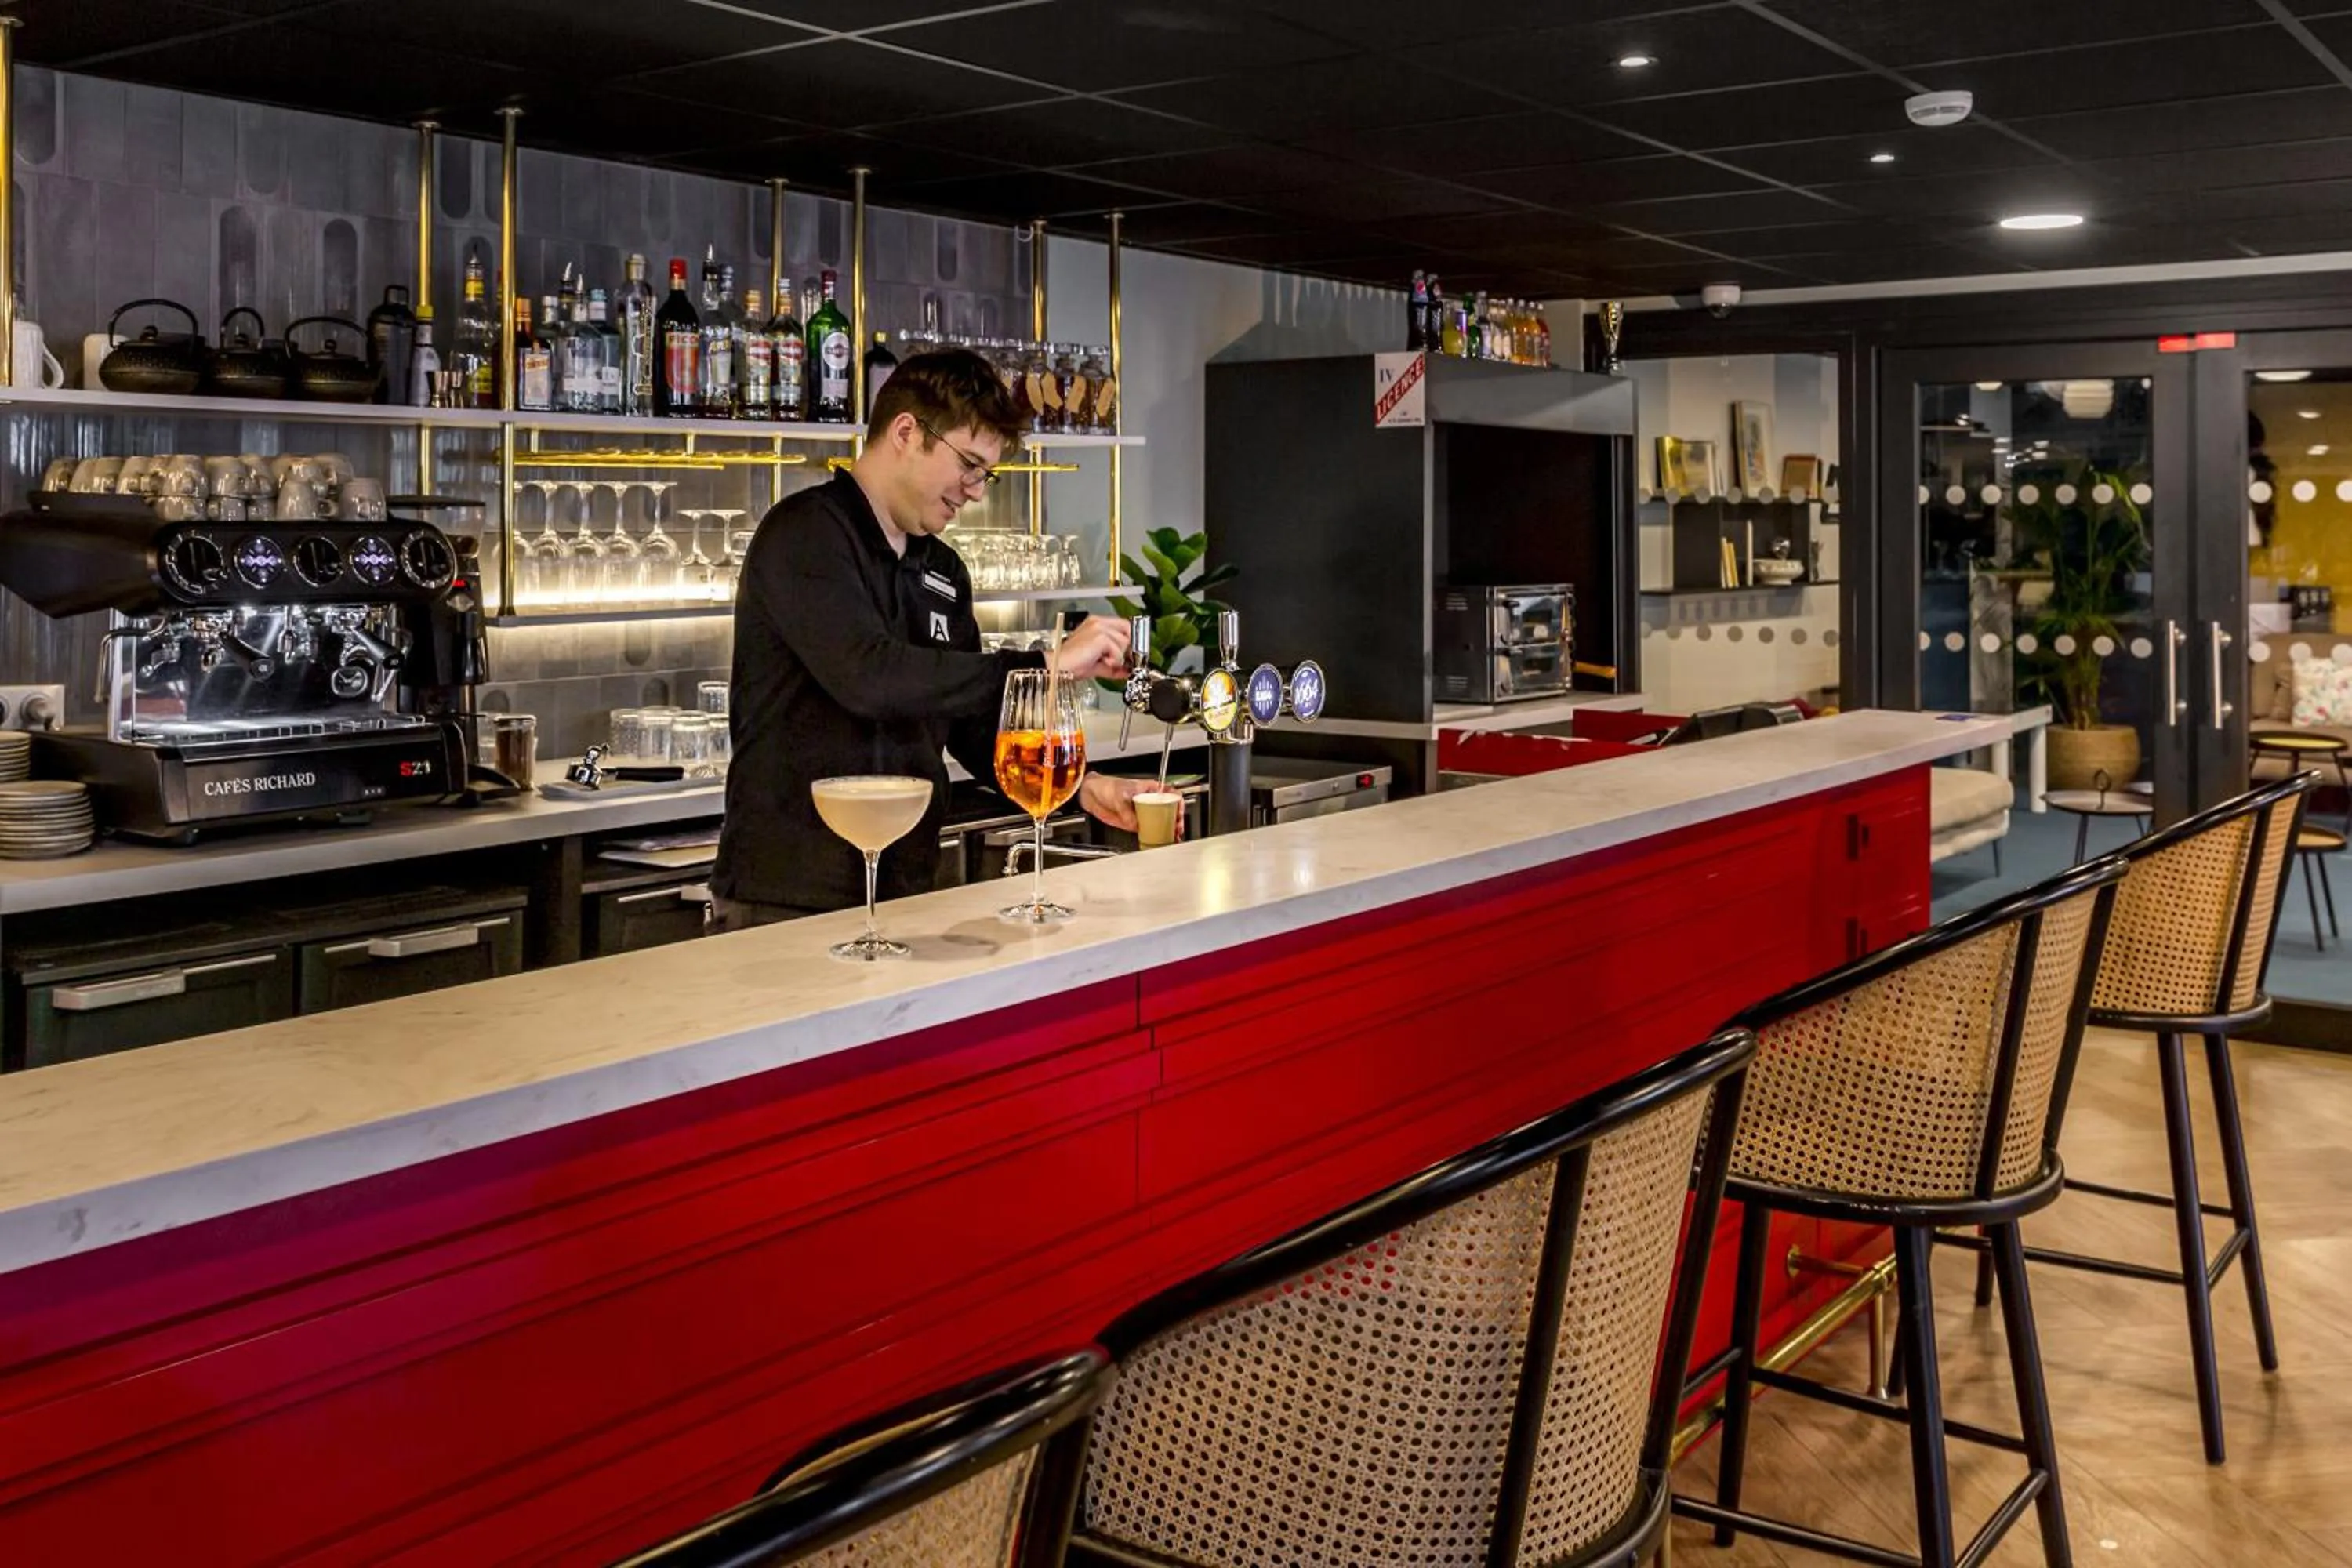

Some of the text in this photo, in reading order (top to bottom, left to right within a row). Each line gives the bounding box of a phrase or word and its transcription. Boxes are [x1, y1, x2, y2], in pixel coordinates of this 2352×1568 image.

[1380, 368, 1394, 383] IV
[930, 612, 949, 641] A
[400, 760, 430, 776] S21
[253, 772, 316, 791] RICHARD
